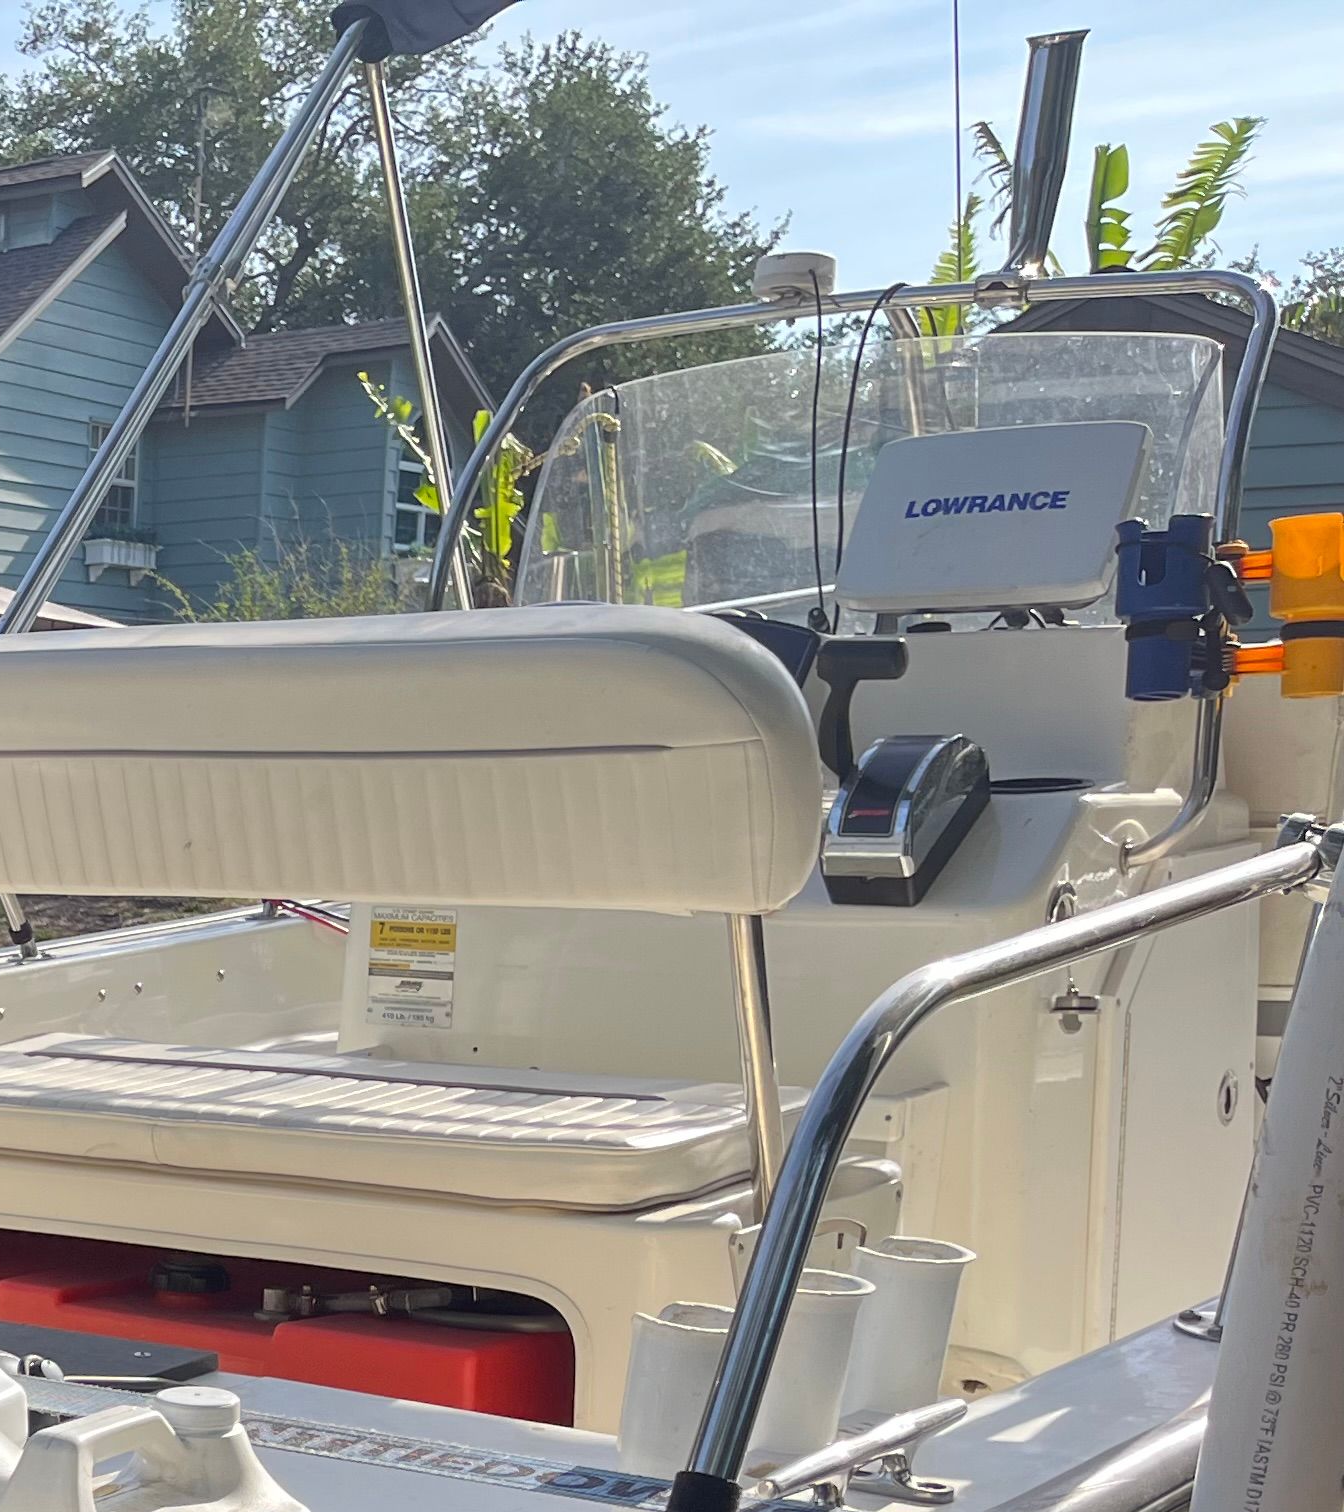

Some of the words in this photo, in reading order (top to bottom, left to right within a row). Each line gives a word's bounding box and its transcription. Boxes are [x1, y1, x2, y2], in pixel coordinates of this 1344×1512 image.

[904, 490, 1070, 519] LOWRANCE
[378, 922, 386, 935] 7
[1296, 1184, 1324, 1253] PVC-1120
[1281, 1312, 1299, 1333] PR
[1269, 1362, 1288, 1388] PSI
[1265, 1389, 1282, 1406] @
